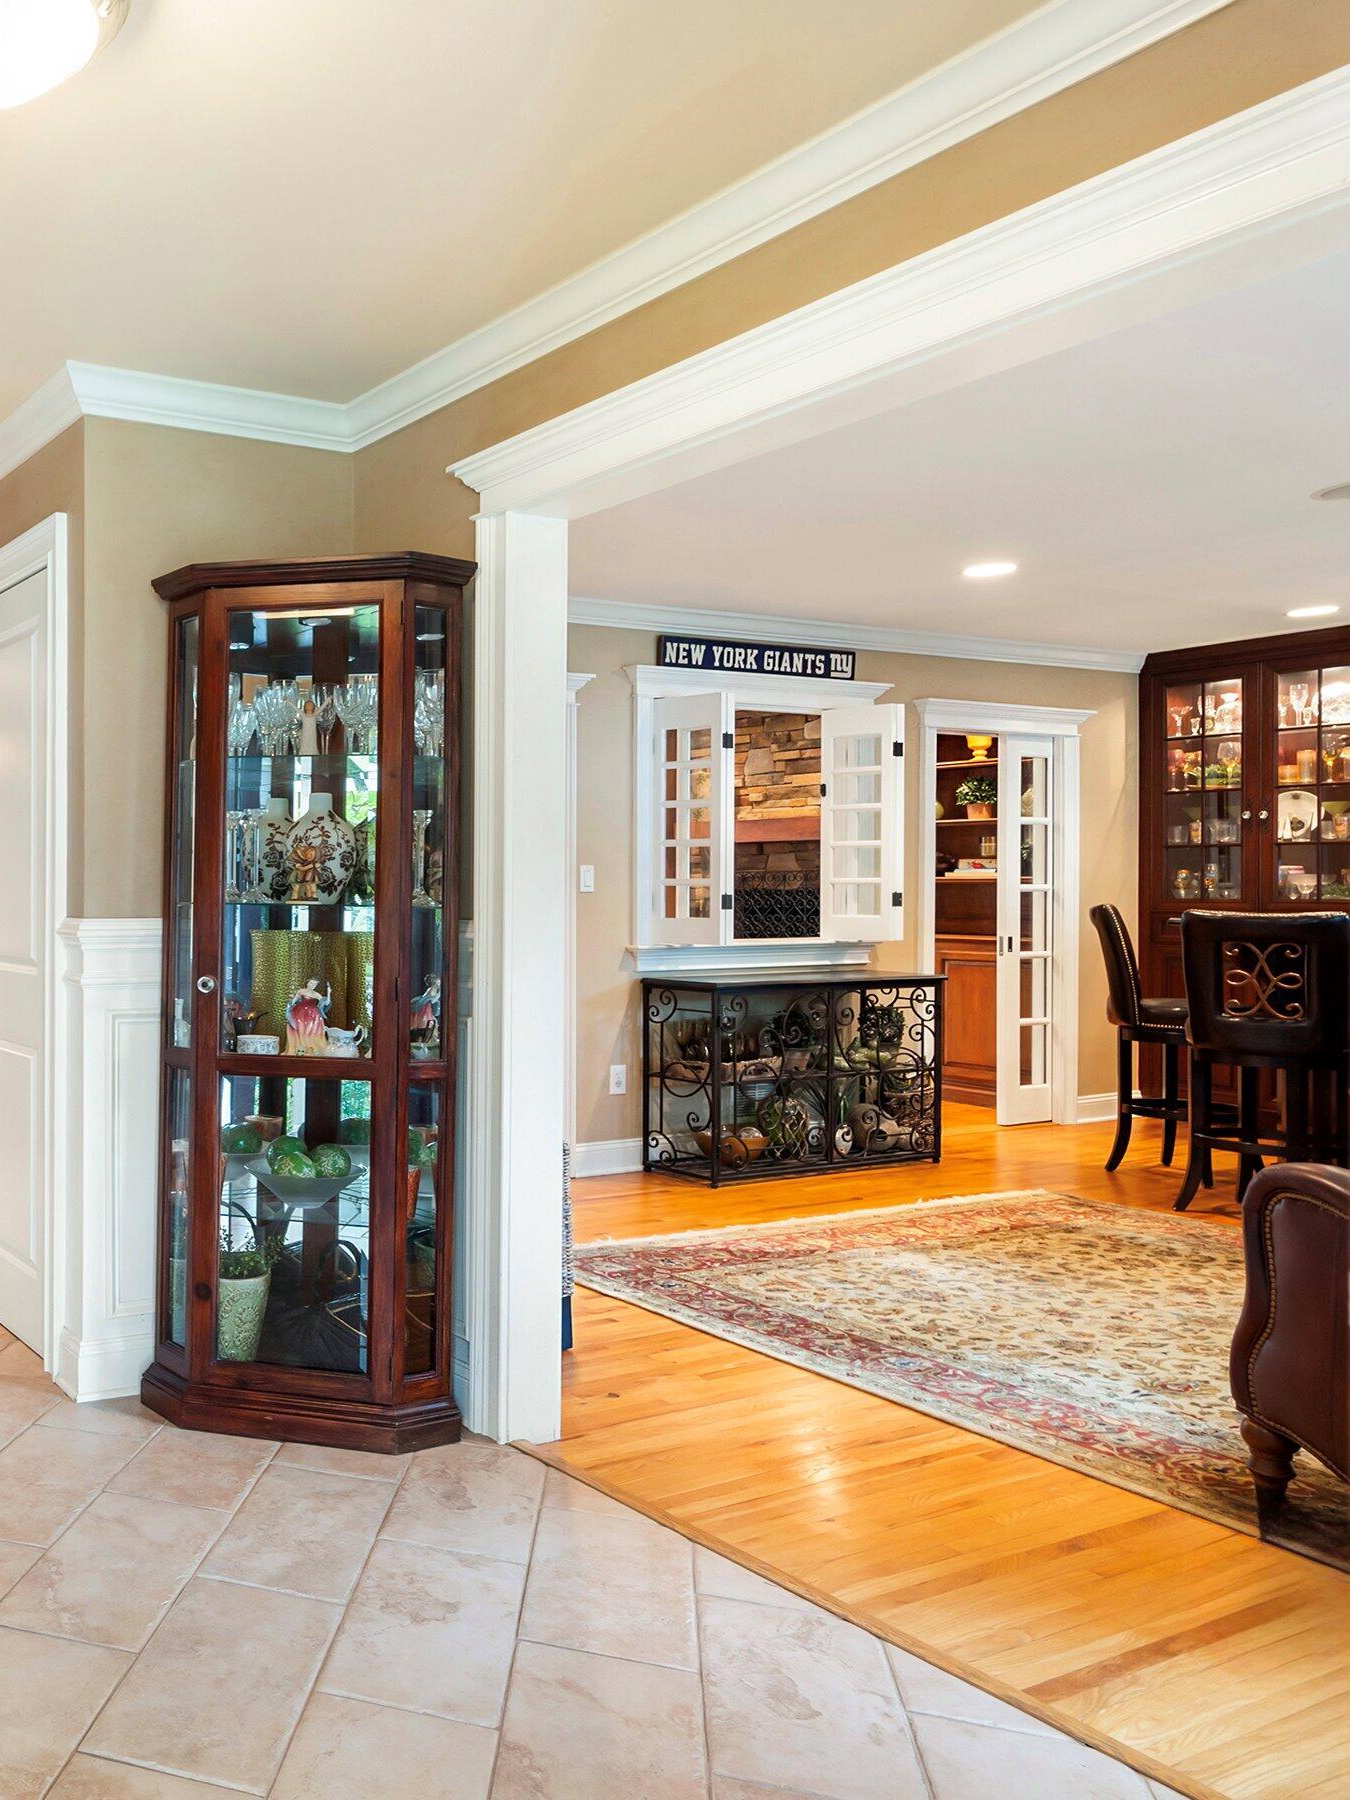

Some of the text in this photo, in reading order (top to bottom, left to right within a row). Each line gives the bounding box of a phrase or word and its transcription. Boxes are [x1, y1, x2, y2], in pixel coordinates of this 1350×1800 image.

[665, 642, 706, 666] NEW
[712, 646, 758, 670] YORK
[763, 651, 825, 675] GIANTS
